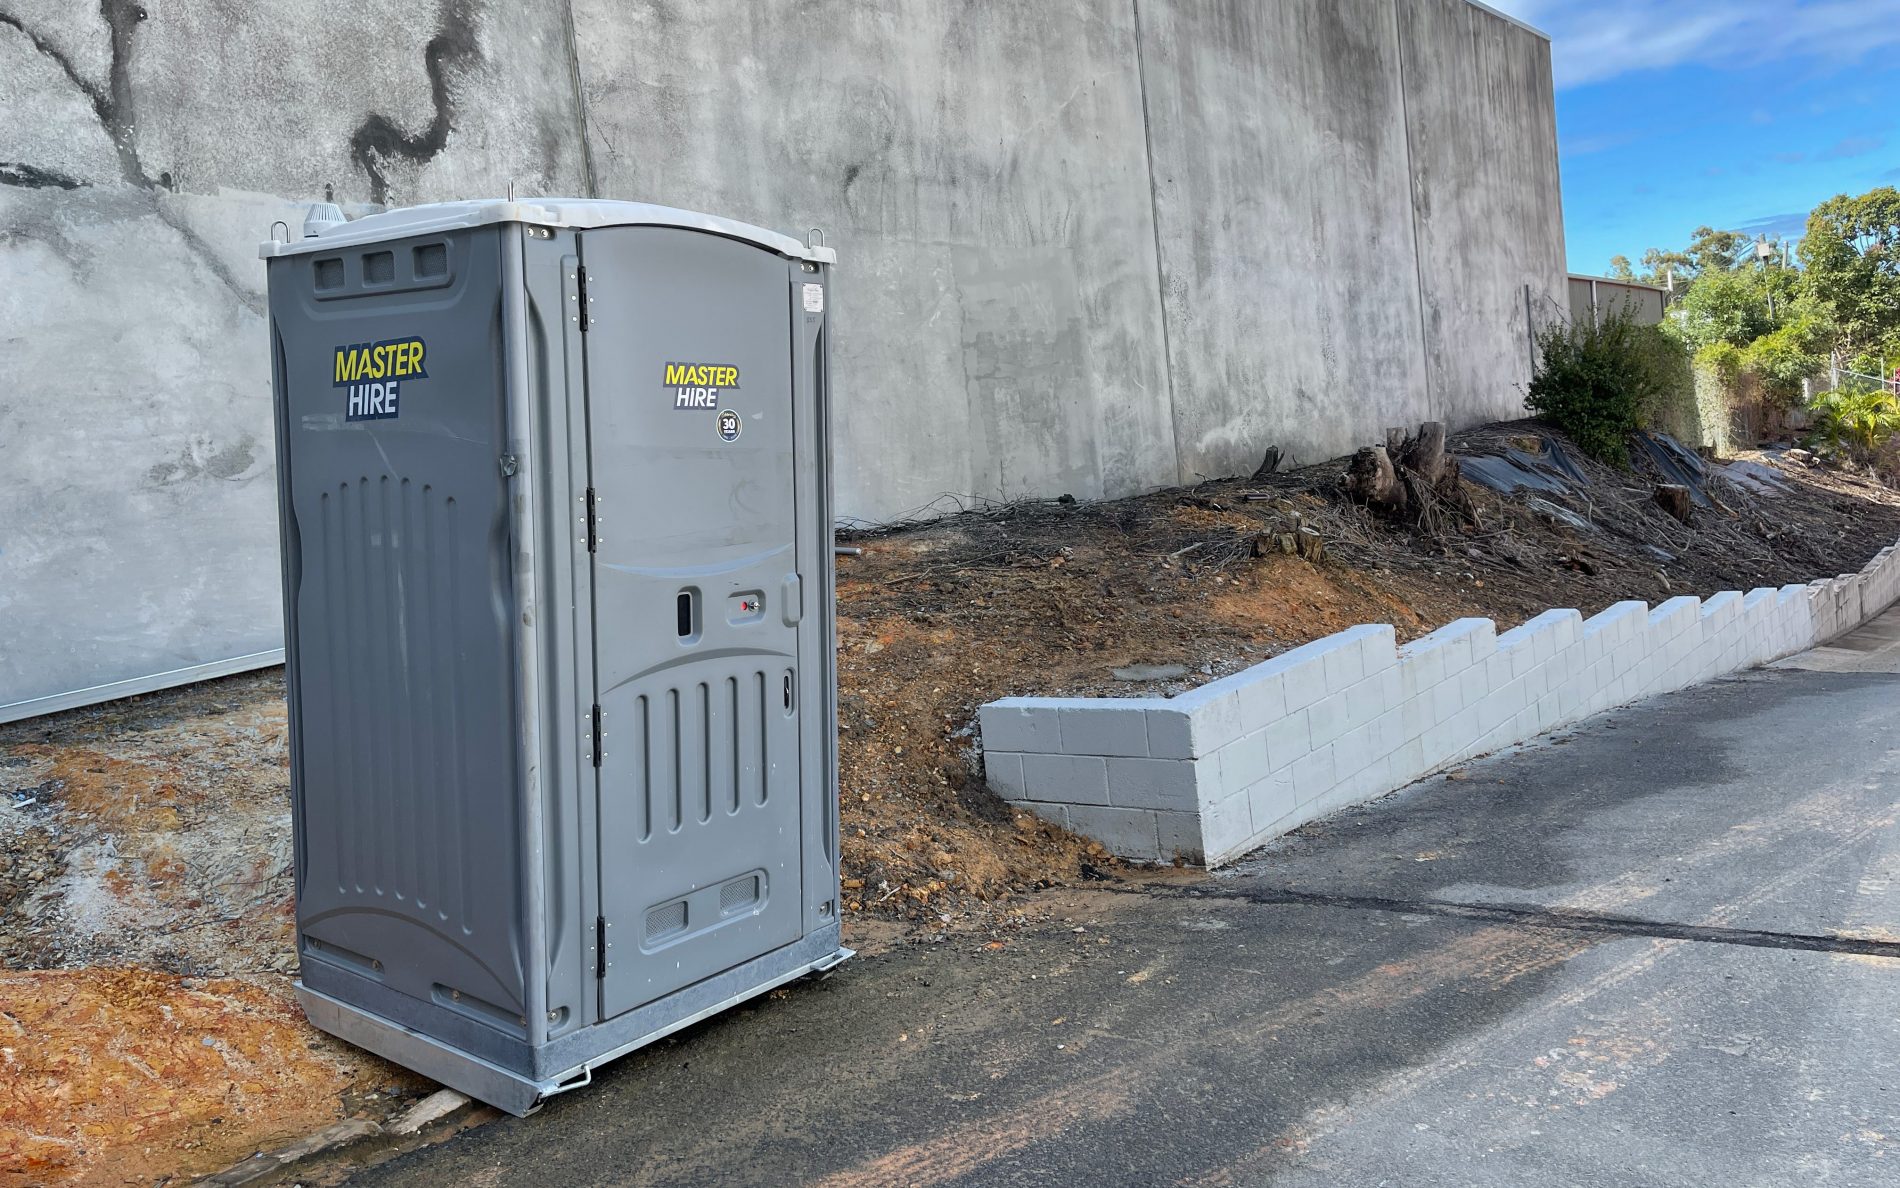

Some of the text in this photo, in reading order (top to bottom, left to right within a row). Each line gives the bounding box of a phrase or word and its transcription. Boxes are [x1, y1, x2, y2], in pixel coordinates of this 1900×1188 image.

[335, 341, 424, 382] MASTER
[665, 364, 738, 386] MASTER
[348, 381, 397, 416] HIRE
[676, 387, 717, 407] HIRE
[722, 418, 736, 430] 30
